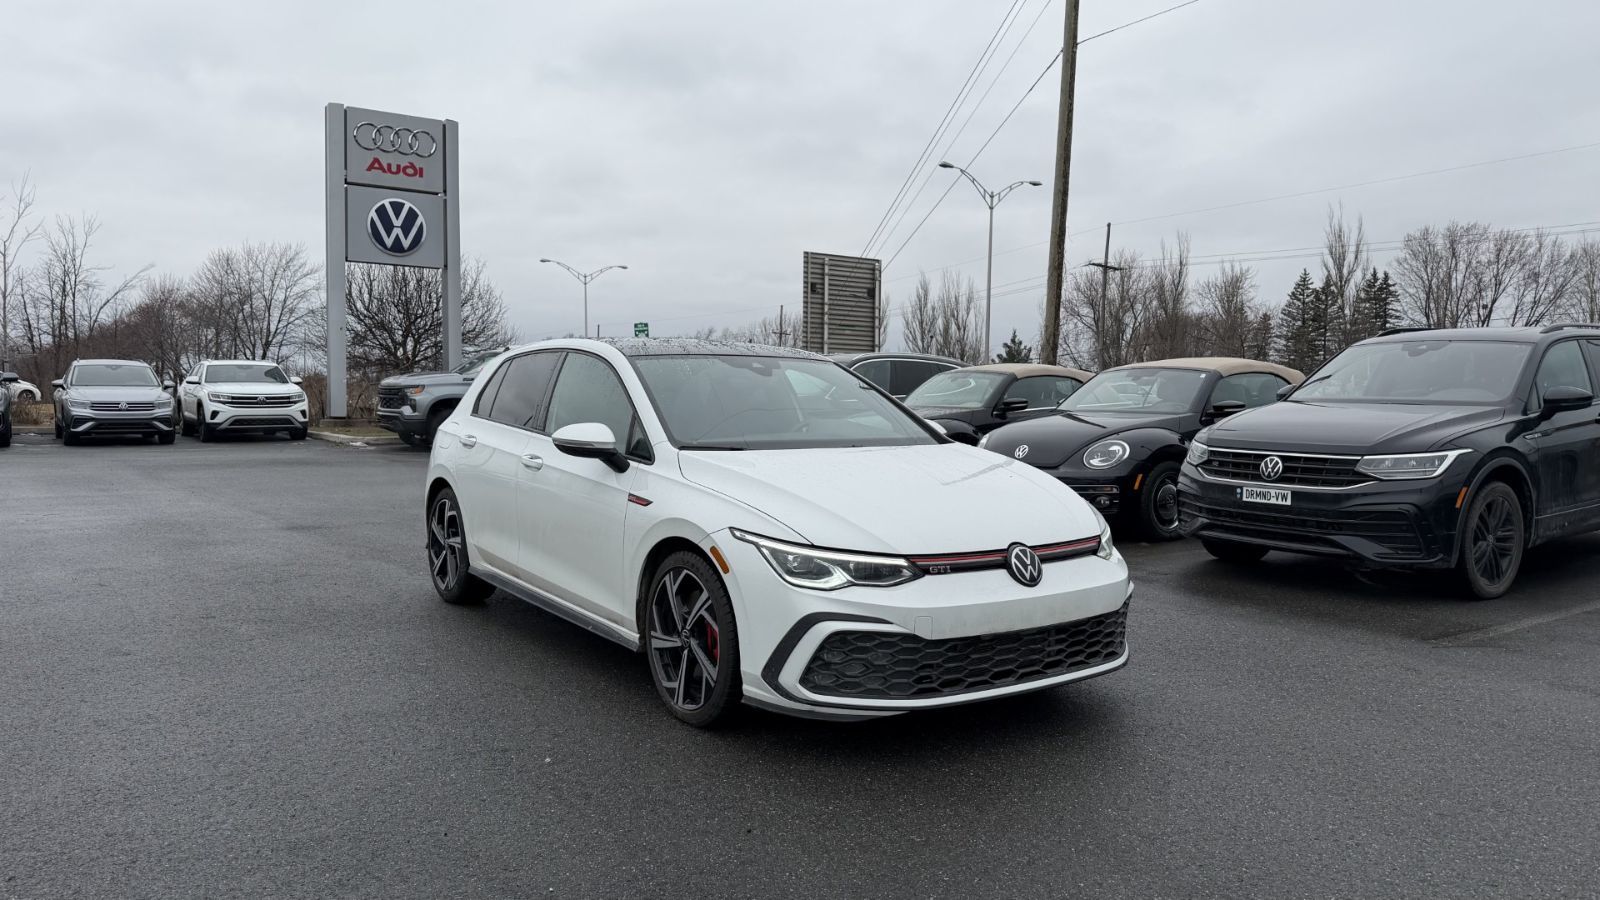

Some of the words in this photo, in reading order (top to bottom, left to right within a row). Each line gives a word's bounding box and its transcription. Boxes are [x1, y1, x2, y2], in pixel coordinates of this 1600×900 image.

[366, 157, 424, 178] Audi
[367, 198, 426, 256] VW
[1245, 488, 1289, 503] DRMND-VW
[929, 565, 952, 574] GTI
